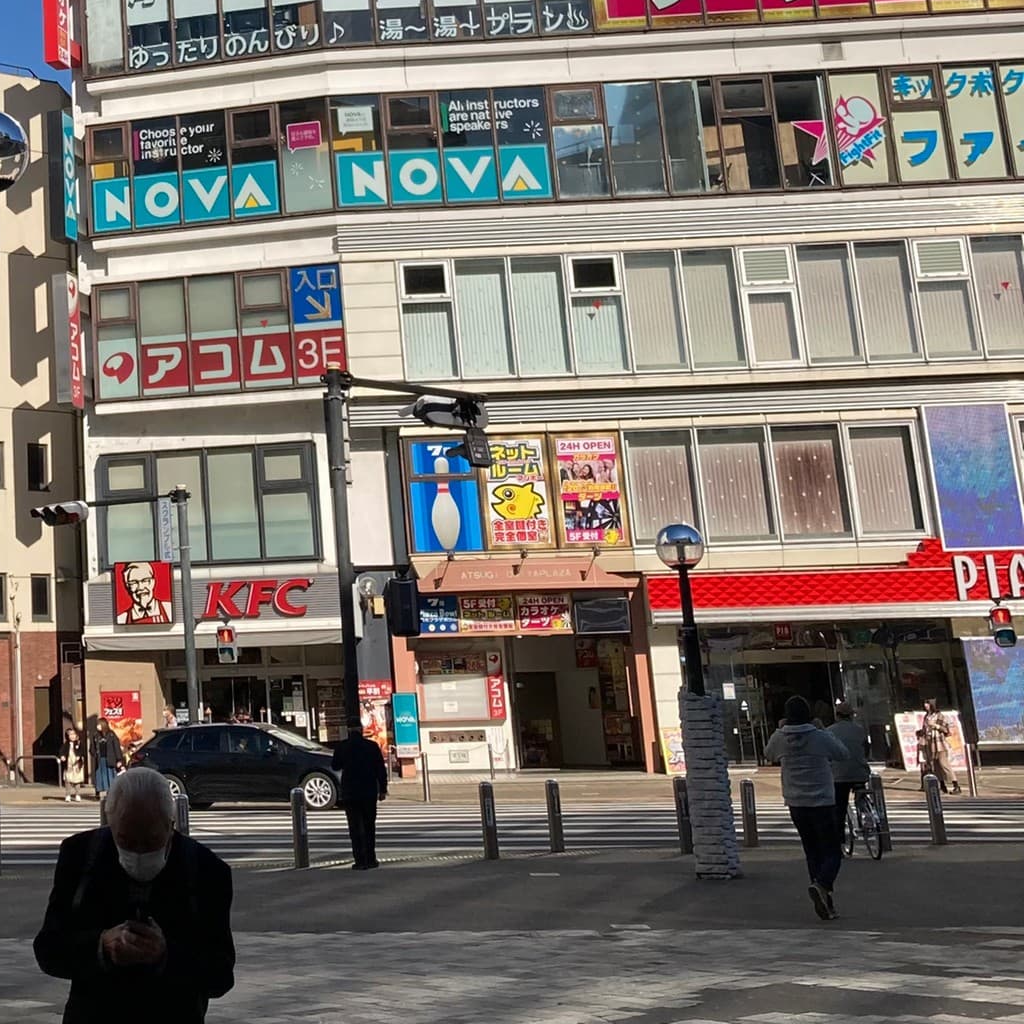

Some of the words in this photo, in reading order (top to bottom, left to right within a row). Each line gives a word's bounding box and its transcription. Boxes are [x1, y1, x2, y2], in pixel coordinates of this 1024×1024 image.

[466, 98, 540, 111] instructors
[449, 112, 468, 122] are
[470, 109, 513, 121] native
[139, 127, 187, 141] Choose
[188, 123, 215, 137] your
[449, 120, 509, 134] speakers
[141, 143, 205, 161] instructor
[64, 134, 76, 221] NOVA
[351, 154, 543, 205] NOVA
[105, 172, 272, 224] NOVA
[295, 268, 337, 293] 入口
[147, 338, 287, 385] アコム
[489, 444, 536, 460] ネット
[560, 442, 580, 451] 24H
[583, 441, 611, 450] OPEN
[491, 462, 540, 478] ルーム
[202, 578, 311, 618] KFC
[490, 678, 503, 708] アコム
